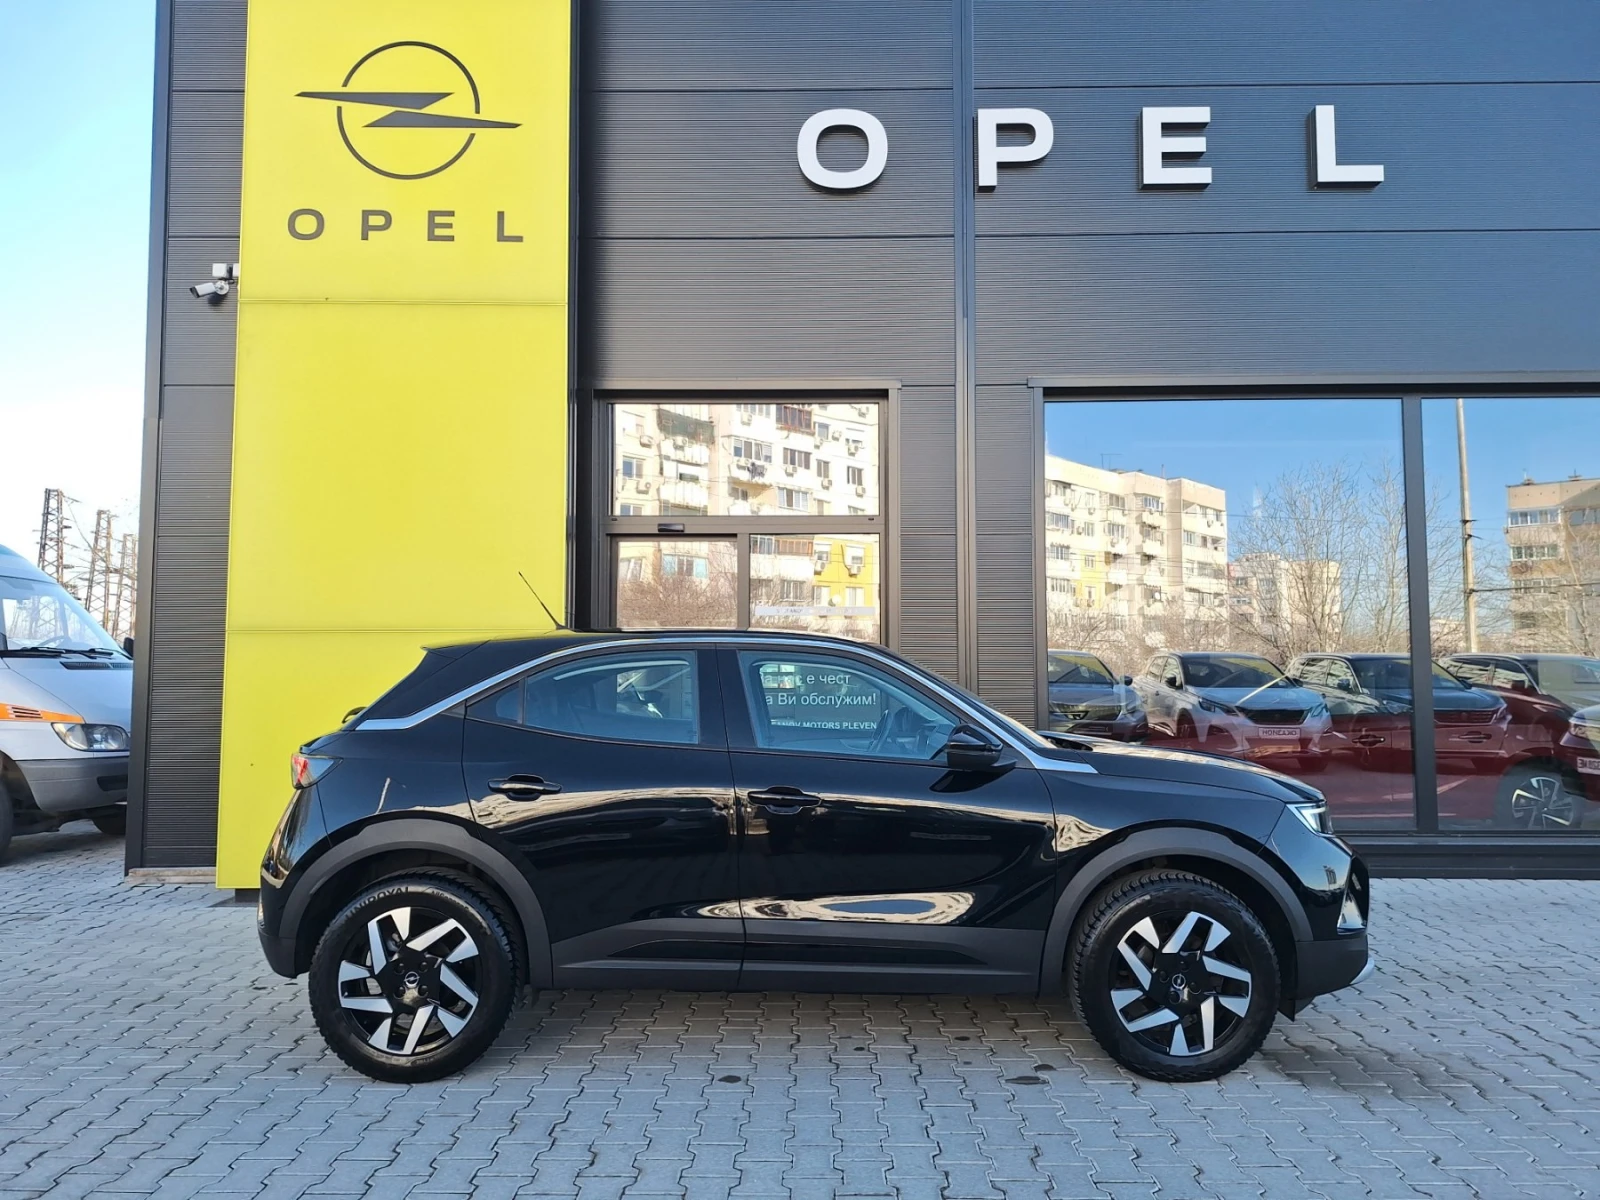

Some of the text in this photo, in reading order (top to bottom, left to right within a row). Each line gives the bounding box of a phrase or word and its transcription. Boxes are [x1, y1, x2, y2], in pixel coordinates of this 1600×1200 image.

[797, 104, 1385, 190] OPEL
[287, 208, 524, 242] OPEL
[806, 675, 815, 685] е
[819, 674, 852, 685] чест
[778, 693, 797, 705] Ви
[800, 692, 877, 708] обслужим!
[803, 721, 841, 730] MOTORS
[842, 721, 878, 730] PLEVEN
